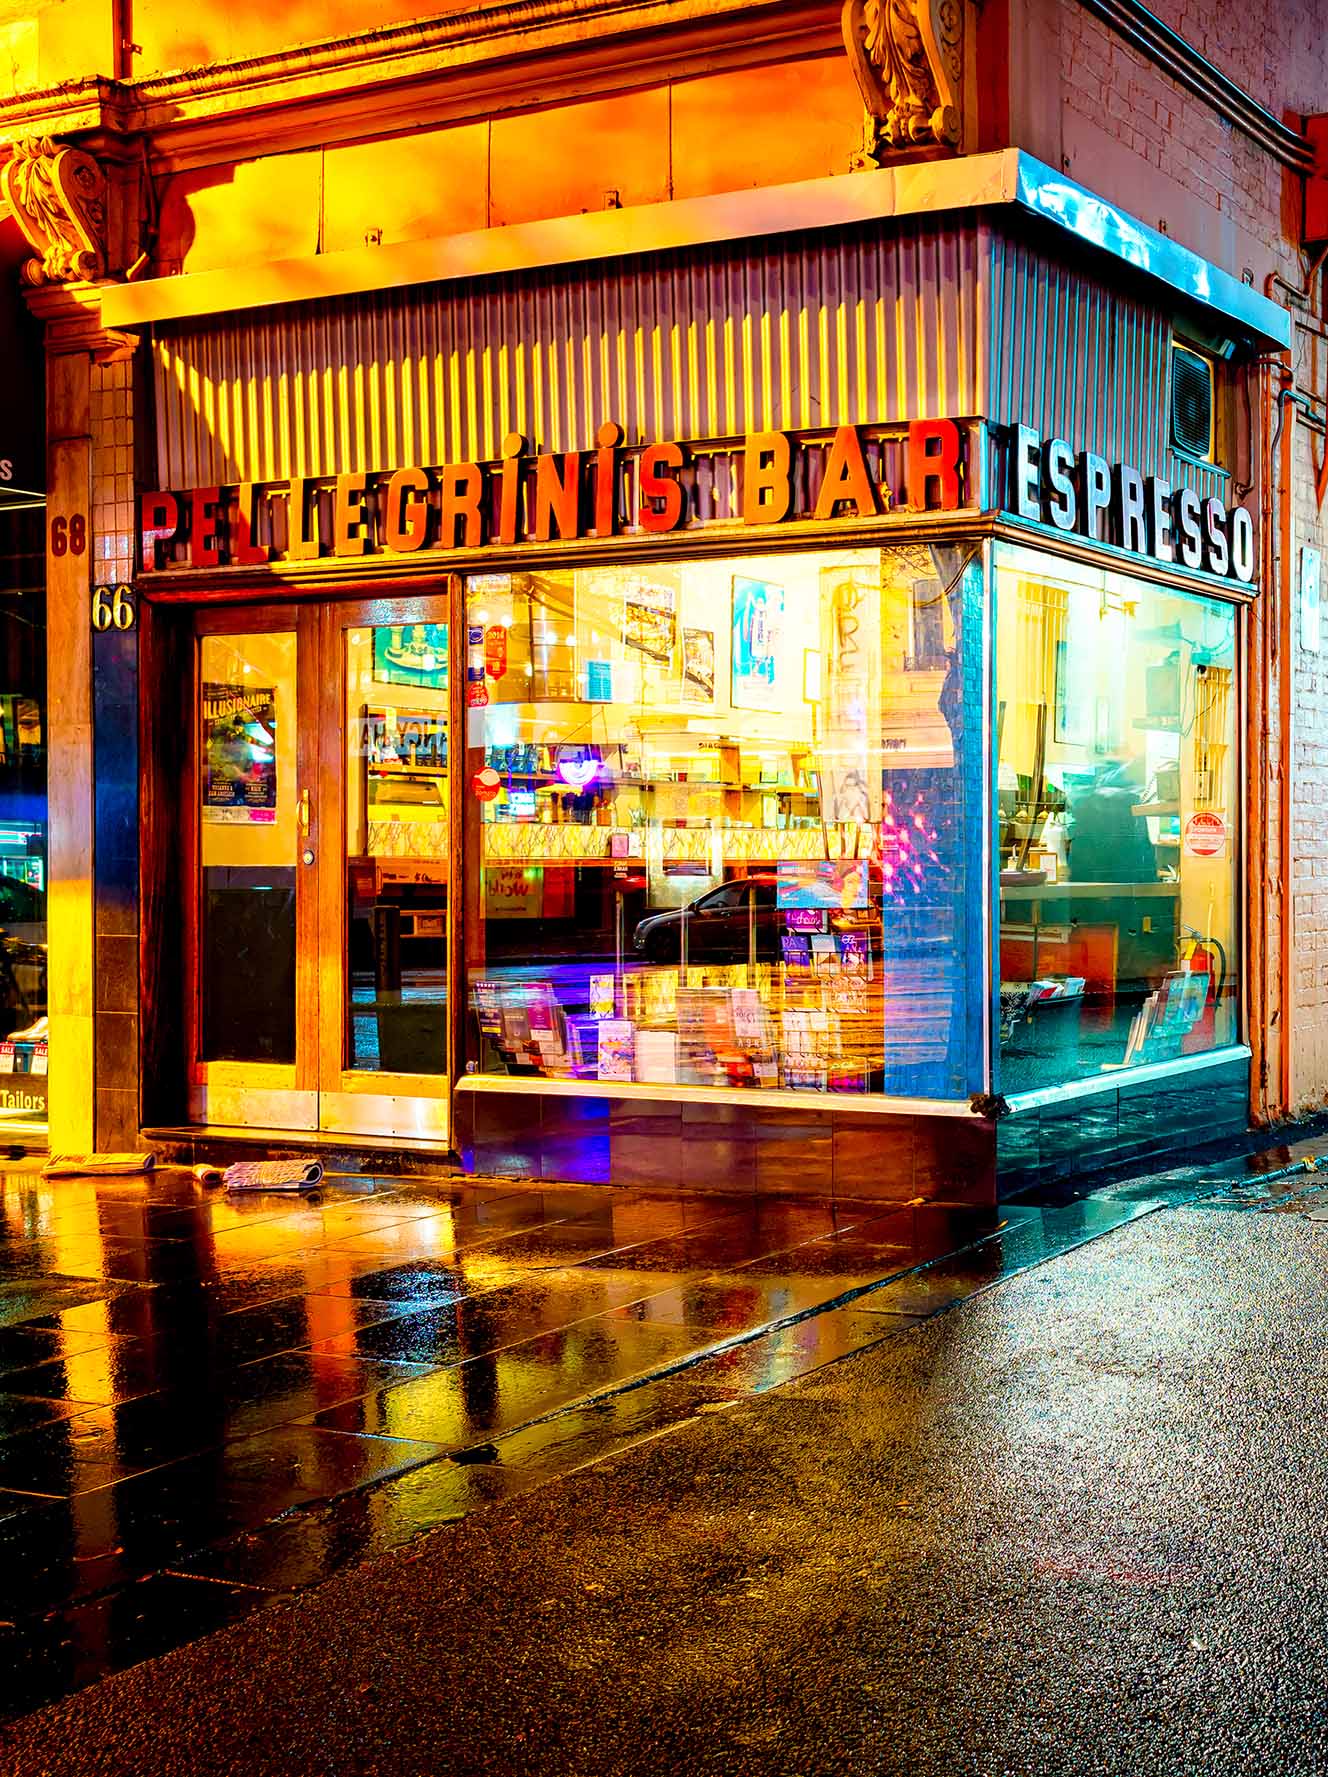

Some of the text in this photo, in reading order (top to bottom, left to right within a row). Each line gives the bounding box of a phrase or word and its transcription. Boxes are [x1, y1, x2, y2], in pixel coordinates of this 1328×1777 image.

[744, 419, 961, 525] BAR
[1015, 423, 1254, 582] ESPRESSO
[51, 513, 86, 557] 68
[92, 584, 133, 631] 66
[203, 693, 271, 720] ILLUSIONAIRE
[34, 1047, 48, 1055] SALE
[0, 1090, 45, 1111] Tailors
